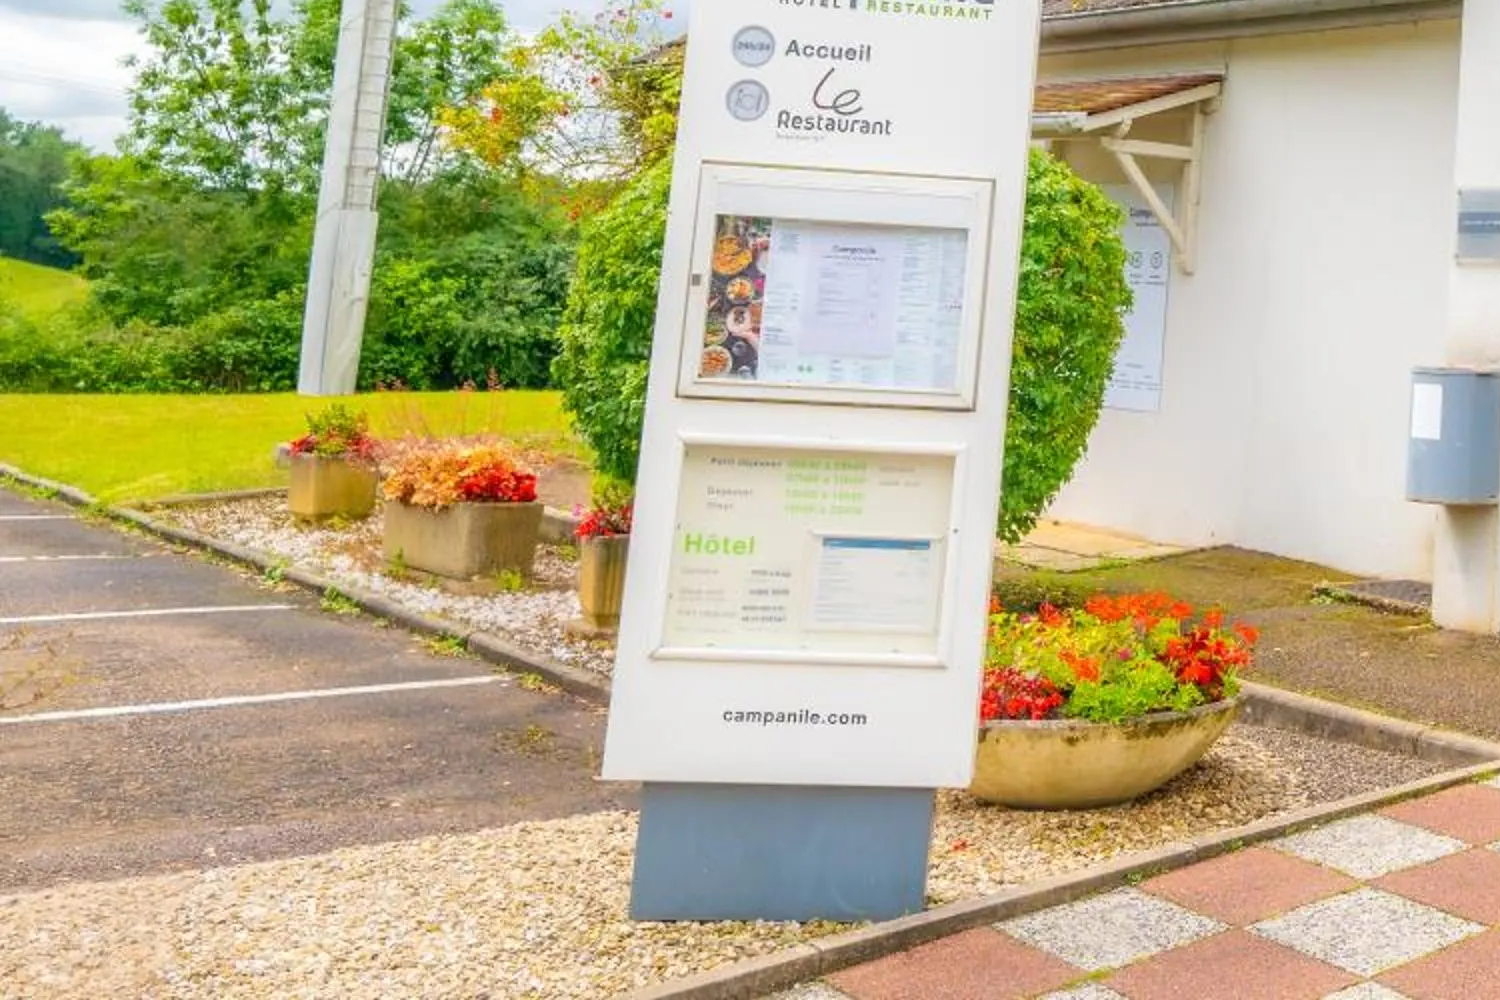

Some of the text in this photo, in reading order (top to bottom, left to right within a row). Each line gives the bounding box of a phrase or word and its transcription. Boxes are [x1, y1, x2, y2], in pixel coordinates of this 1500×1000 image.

[866, 0, 993, 21] RESTAURANT
[785, 39, 872, 62] Accueil
[813, 67, 862, 116] Le
[777, 110, 894, 136] Restaurant
[723, 709, 868, 726] campanile.com
